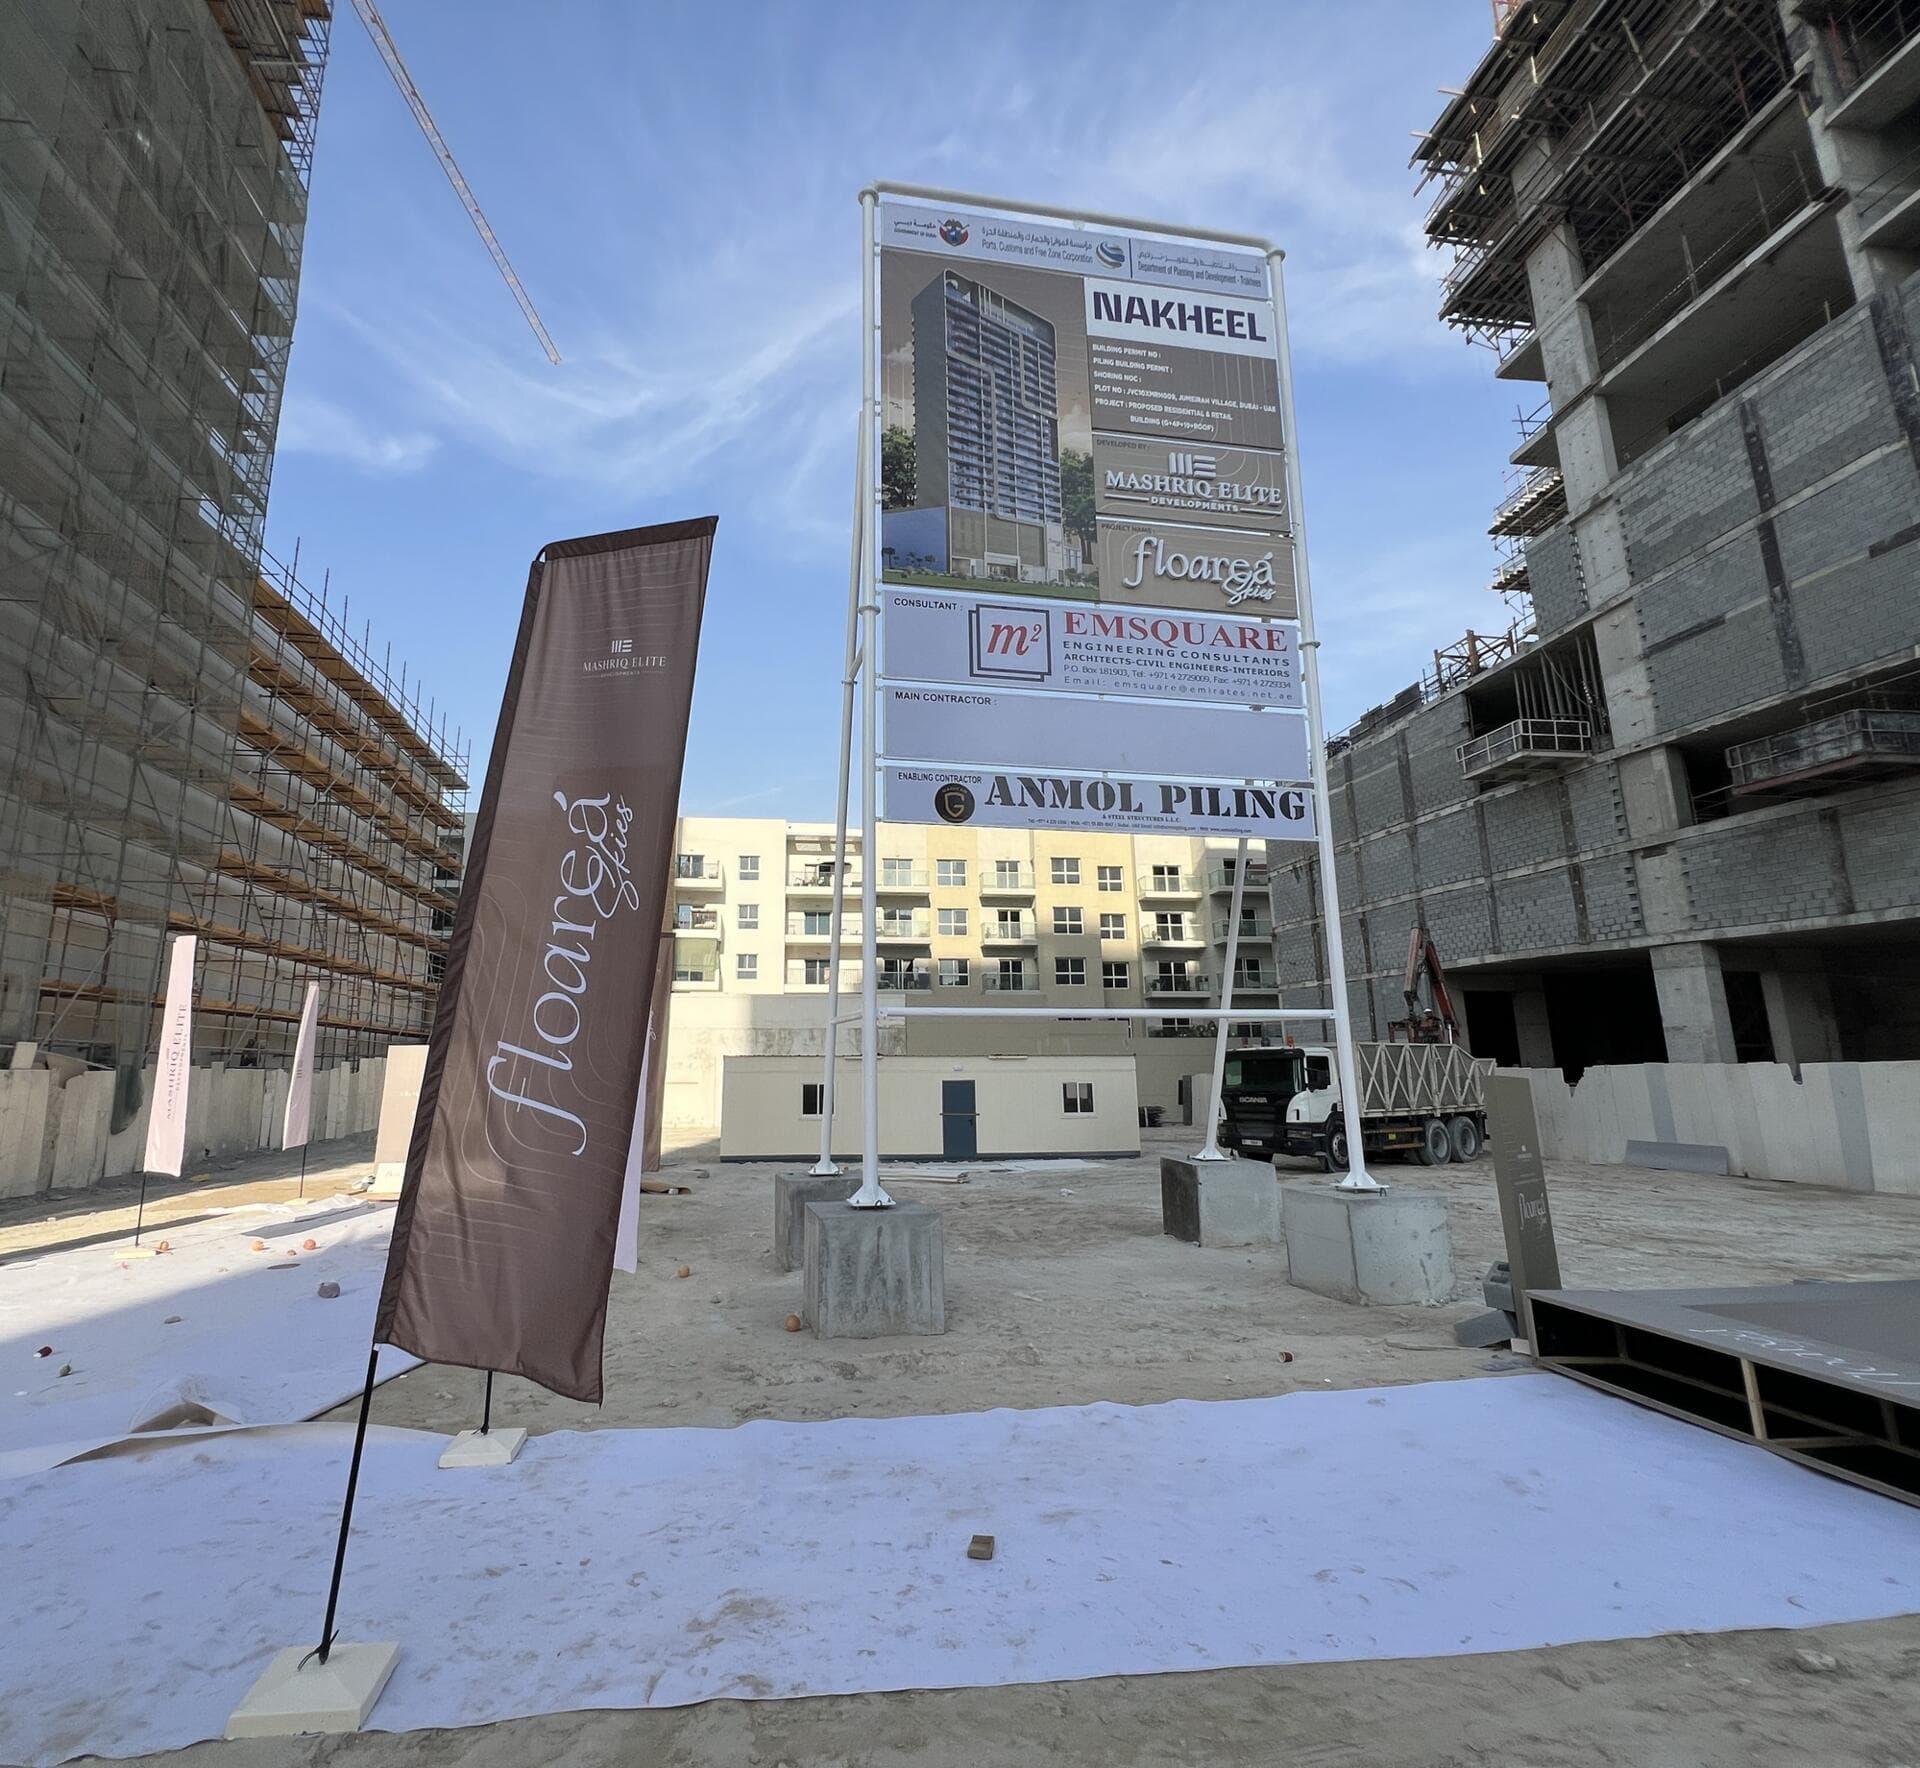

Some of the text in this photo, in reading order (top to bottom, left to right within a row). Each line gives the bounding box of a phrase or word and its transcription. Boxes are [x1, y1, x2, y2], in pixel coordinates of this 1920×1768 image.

[999, 241, 1023, 255] Customs
[1024, 245, 1035, 256] and
[1035, 246, 1048, 257] Free
[1048, 247, 1061, 260] Zone
[1062, 250, 1094, 264] Corporation
[1138, 260, 1167, 274] Department
[1167, 264, 1173, 275] of
[1174, 265, 1195, 280] Planning
[1195, 269, 1204, 280] and
[1205, 270, 1237, 284] Development
[1093, 291, 1267, 342] NAKHEEL
[1092, 343, 1122, 354] BUILDING
[1124, 347, 1147, 357] PERMIT
[1148, 351, 1158, 359] NO
[1093, 357, 1114, 366] PILING
[1115, 359, 1146, 370] BUILDING
[1146, 364, 1170, 373] PERMIT
[1093, 370, 1122, 380] SHORING
[1124, 374, 1138, 382] NOC
[1094, 384, 1111, 392] PLOT
[1112, 386, 1122, 394] NO
[1179, 394, 1210, 405] JUMEIRAH
[1211, 398, 1238, 408] VILLAGE,
[1240, 401, 1258, 410] DUBAI
[1263, 405, 1276, 413] UAE
[1095, 397, 1123, 407] PROJECT
[1128, 402, 1163, 412] PROPOSED
[1164, 405, 1205, 417] RESIDENTIAL
[1211, 412, 1232, 420] RETAIL
[1130, 415, 1160, 425] BUILDING
[1096, 439, 1136, 449] DEVELOPED
[1105, 470, 1282, 506] MASHRIQ ELITE
[1151, 496, 1240, 513] DEVELOPMENTS
[894, 597, 957, 611] CONSULTANT
[1063, 611, 1288, 652] EMSQUARE
[583, 656, 667, 672] MASHRIQ ELITE
[1062, 640, 1290, 667] ENGINEERING CONSULTANTS
[1064, 653, 1290, 678] ARCHITECTS-CIVIL ENGINEERS-INTERIORS
[1082, 665, 1097, 674] Box
[1148, 671, 1169, 680] +971
[1169, 672, 1176, 680] 4
[1232, 678, 1252, 687] +971
[895, 691, 920, 701] MAIN
[922, 693, 992, 706] CONTRACTOR
[898, 772, 983, 784] ENABLING CONTRACTOR
[984, 776, 1305, 820] ANMOL PILING
